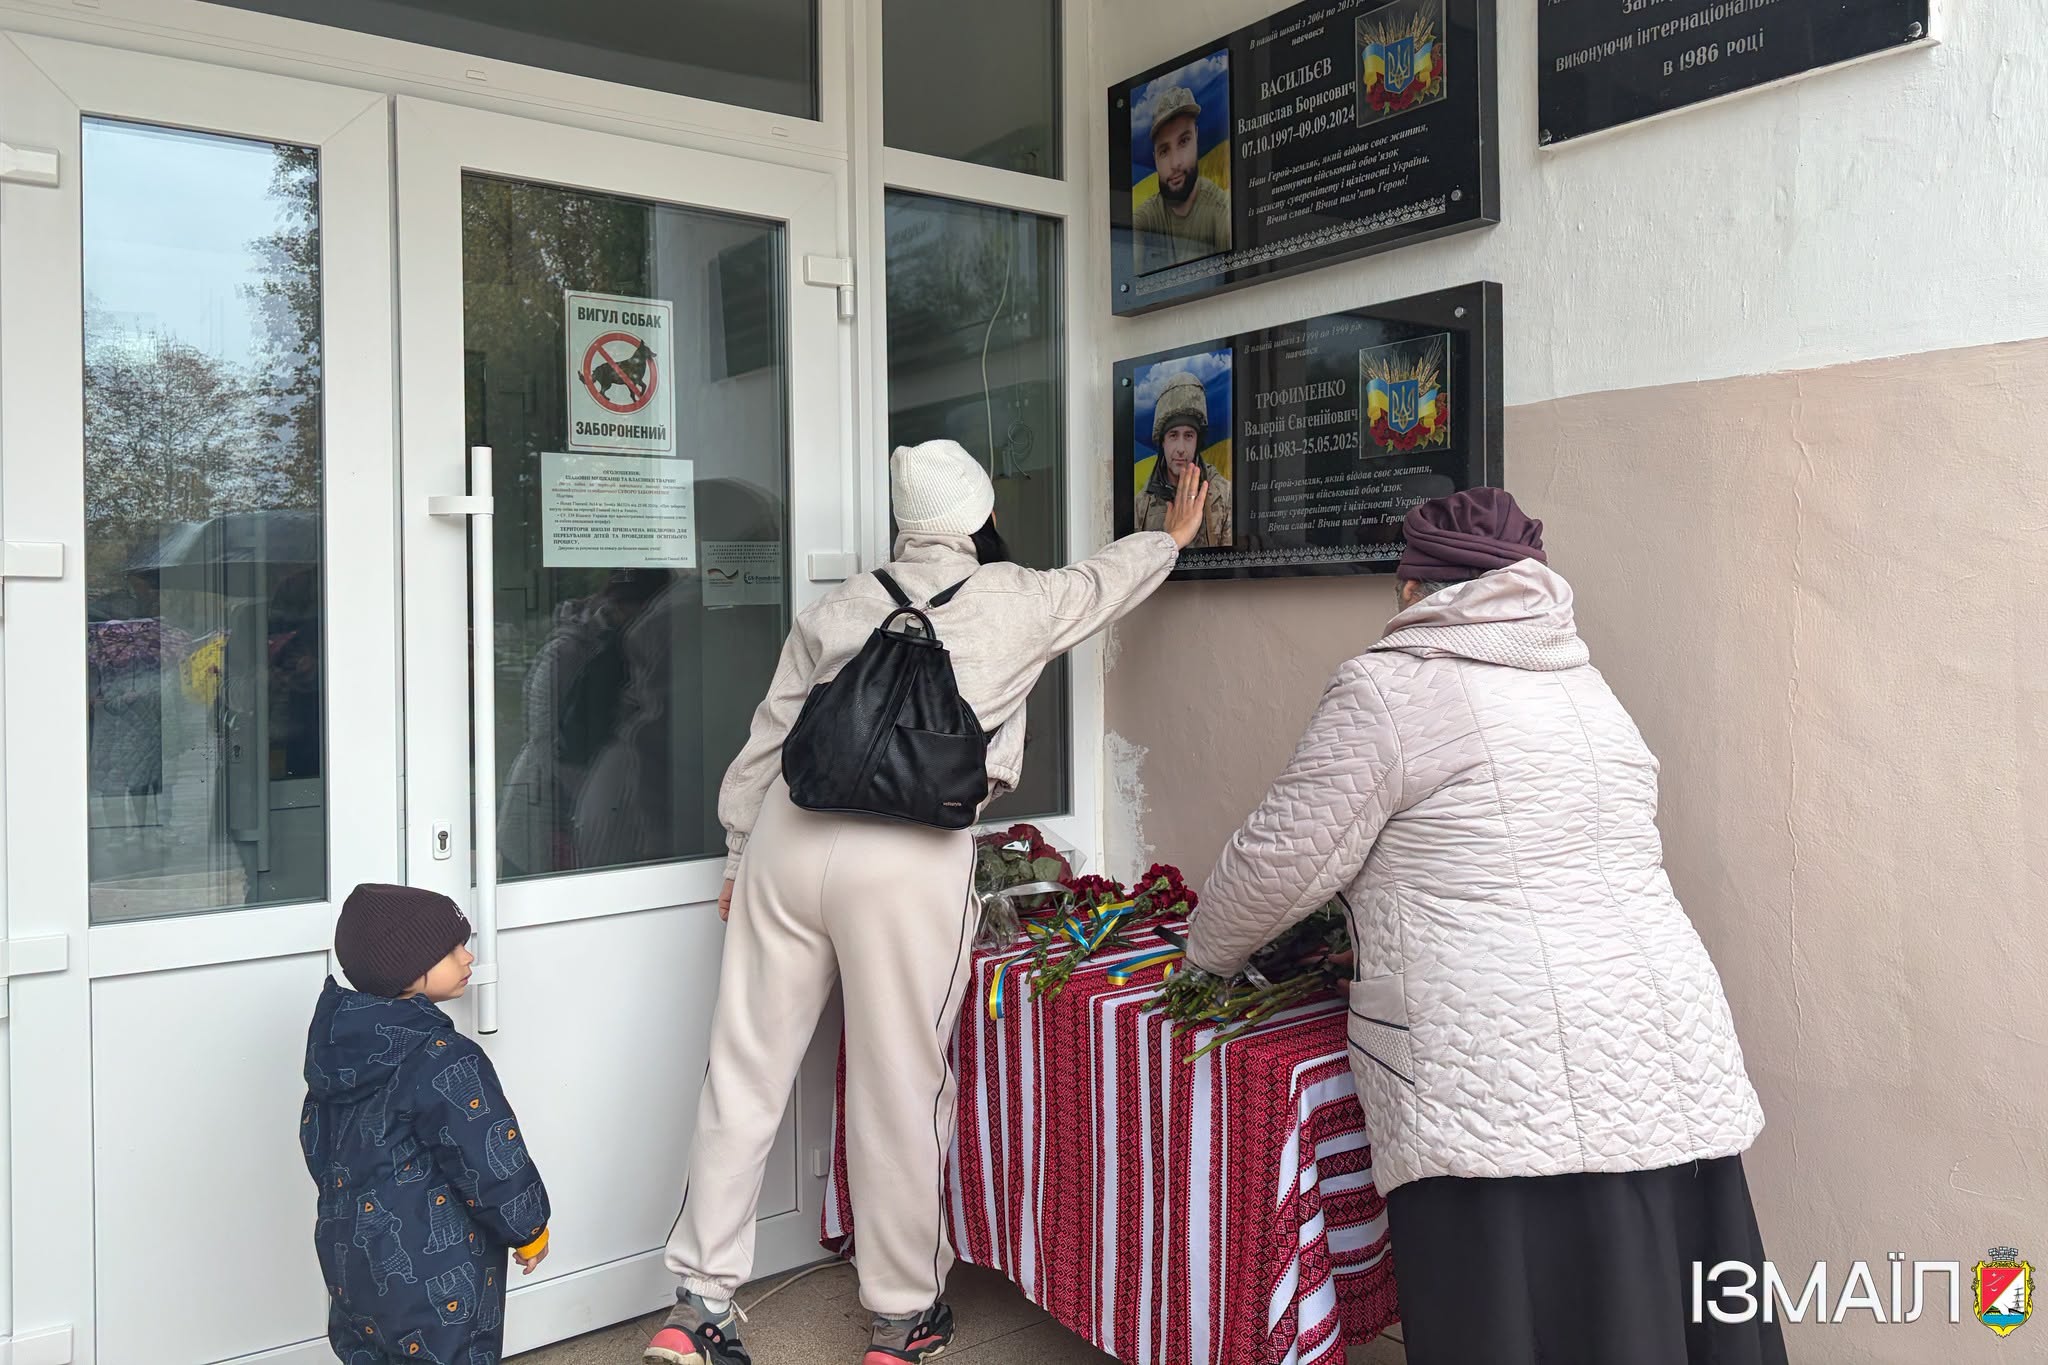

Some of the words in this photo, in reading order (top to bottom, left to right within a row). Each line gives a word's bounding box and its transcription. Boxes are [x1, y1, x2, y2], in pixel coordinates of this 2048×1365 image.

[1556, 34, 1633, 72] виконуючи
[1663, 60, 1673, 76] в
[1679, 43, 1719, 71] 1986
[1727, 28, 1764, 57] році
[1261, 57, 1332, 100] ВАСИЛЬЄВ
[1238, 104, 1293, 135] Владислав
[1295, 81, 1356, 113] Борисович
[1249, 177, 1266, 188] Наш
[1322, 150, 1342, 166] який
[1389, 124, 1429, 142] життя,
[1315, 197, 1338, 212] Вічна
[1377, 175, 1409, 195] Герою!
[577, 306, 618, 324] ВИГУЛ
[622, 311, 662, 329] СОБАК
[1255, 379, 1346, 409] ТРОФИМЕНКО
[575, 421, 666, 441] ЗАБОРОНЕНИЙ
[1244, 416, 1285, 437] Валерій
[1288, 408, 1358, 431] Євгенійович
[1250, 481, 1268, 491] Наш
[1324, 472, 1345, 484] який
[1393, 465, 1432, 477] життя,
